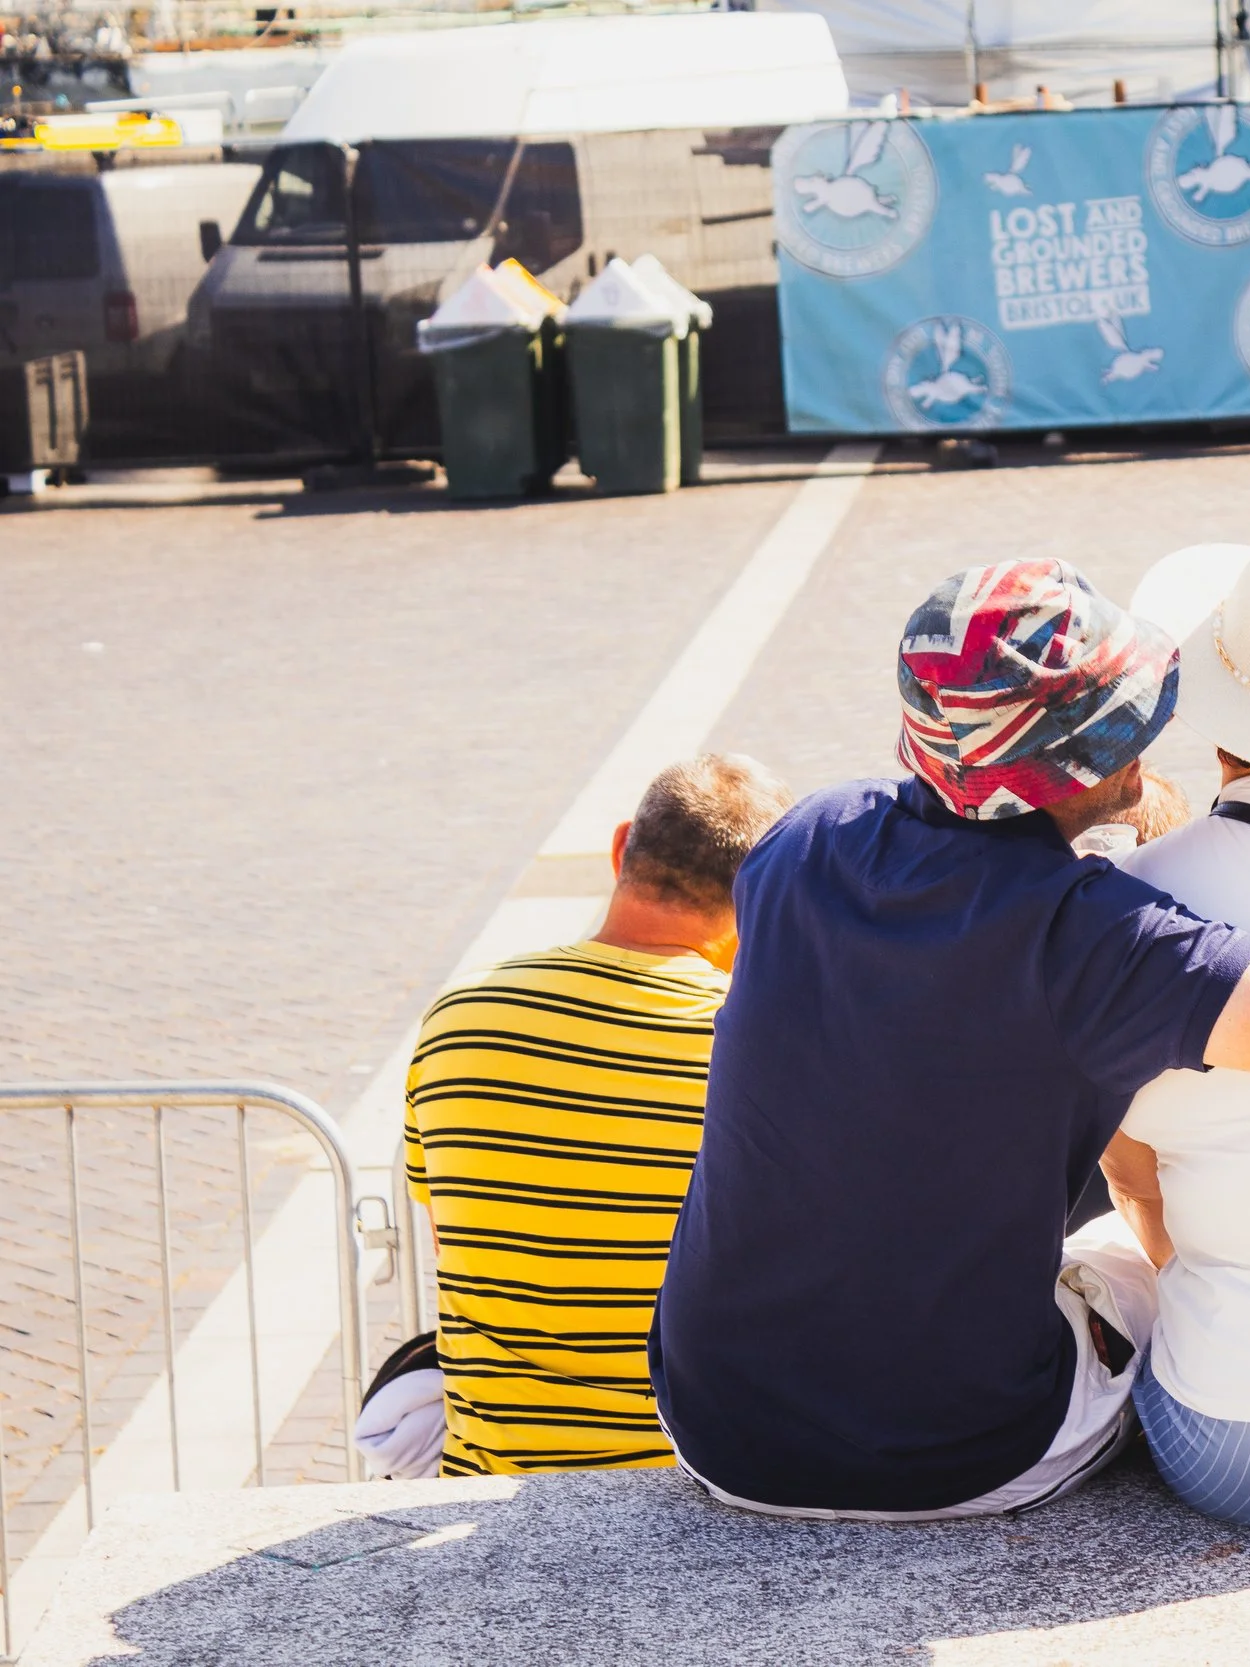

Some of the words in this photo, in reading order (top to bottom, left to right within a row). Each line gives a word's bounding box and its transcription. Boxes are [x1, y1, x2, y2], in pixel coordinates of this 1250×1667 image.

[990, 202, 1076, 240] LOST
[1086, 199, 1143, 226] AND
[992, 228, 1148, 265] GROUNDED
[995, 255, 1150, 296] BREWERS
